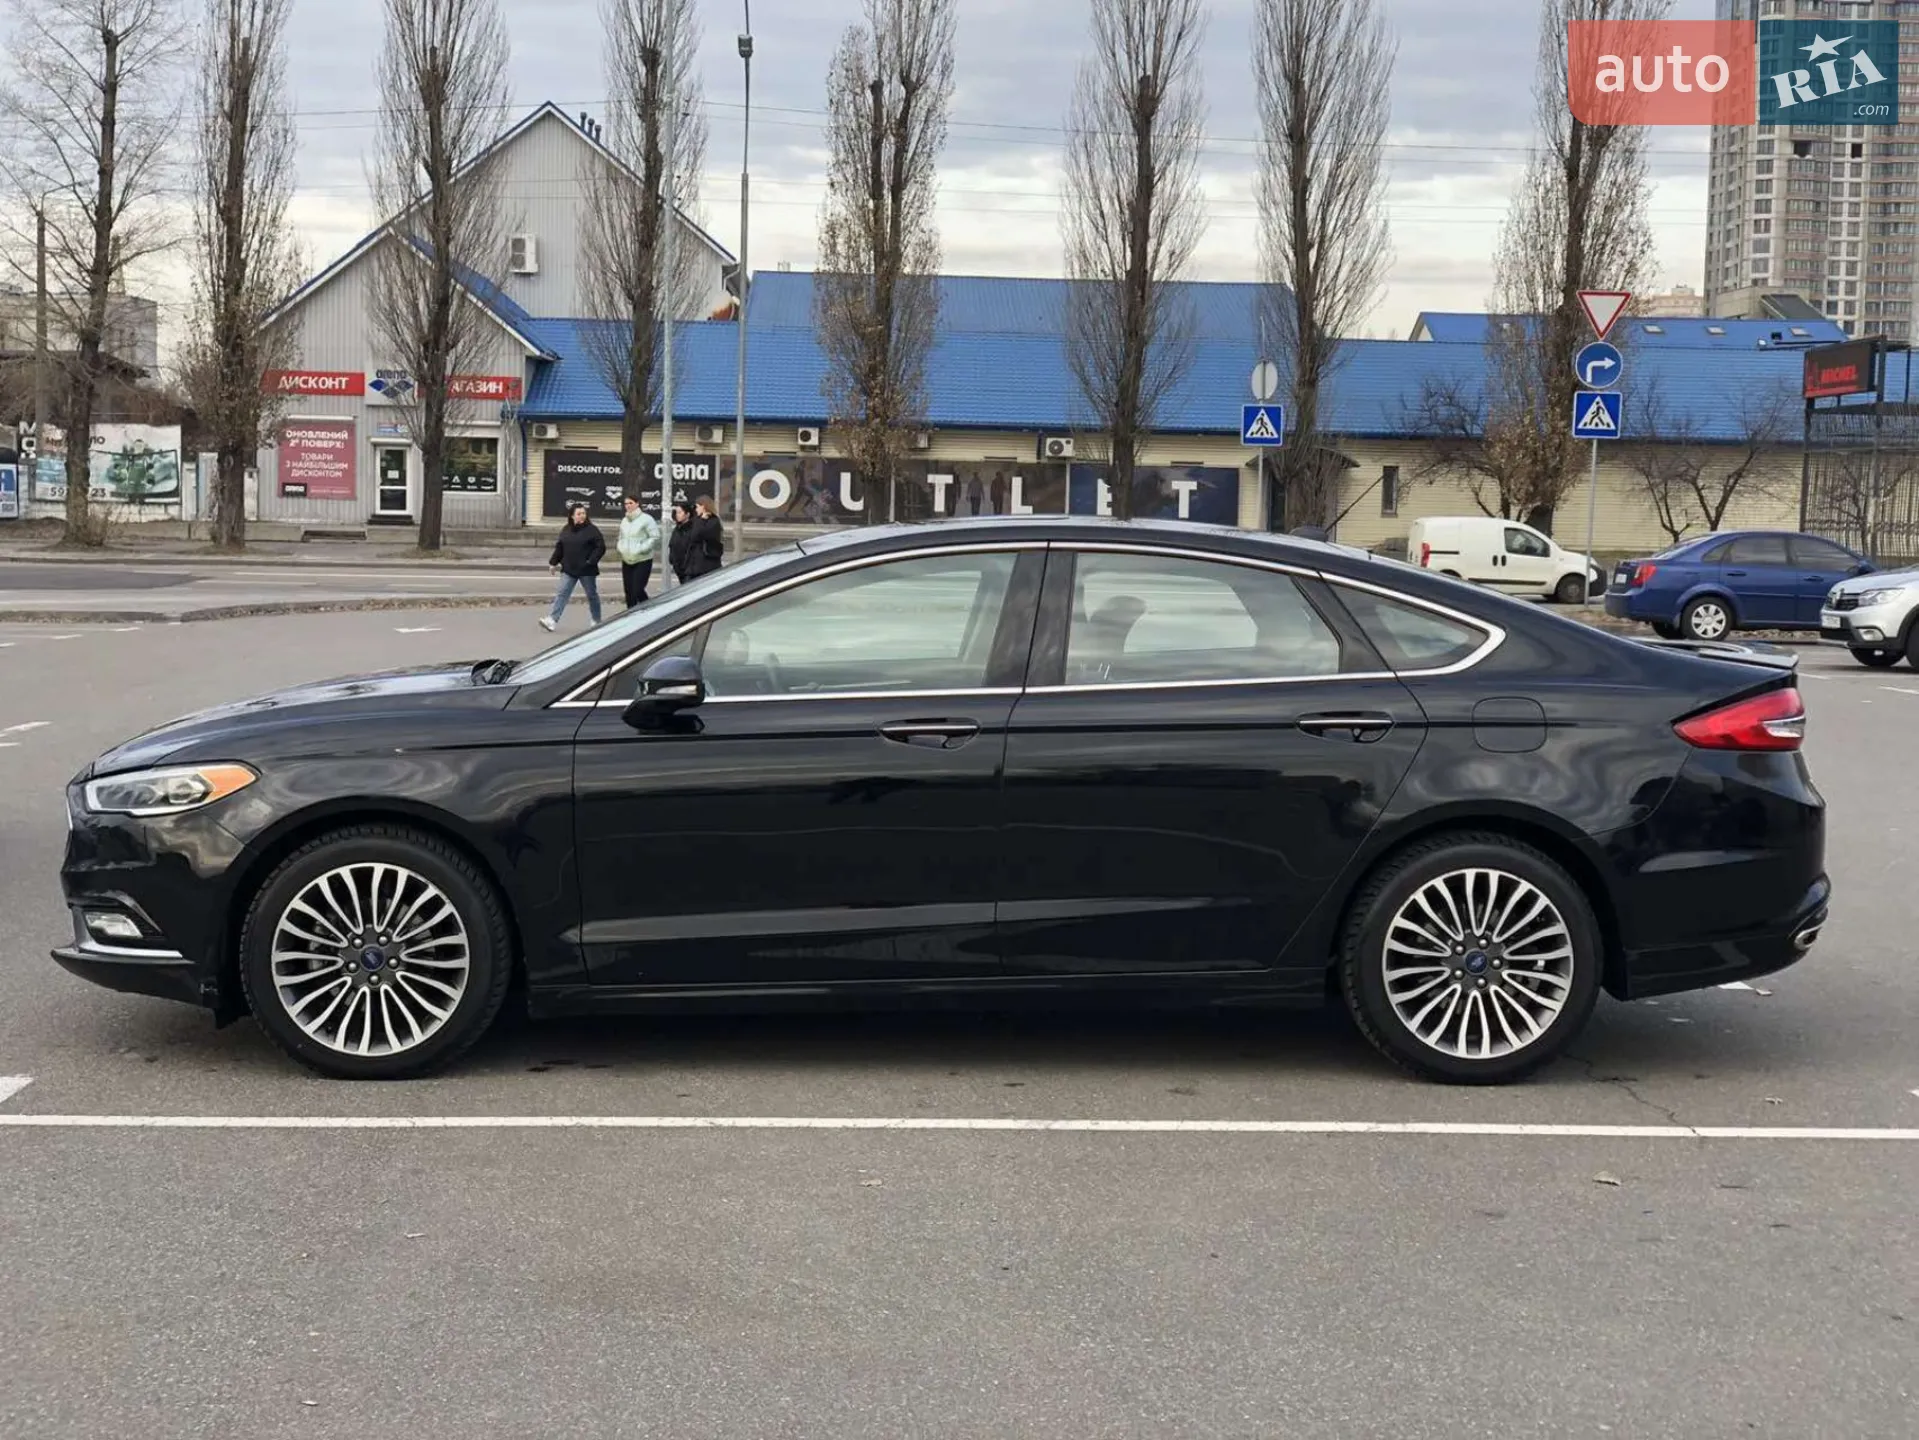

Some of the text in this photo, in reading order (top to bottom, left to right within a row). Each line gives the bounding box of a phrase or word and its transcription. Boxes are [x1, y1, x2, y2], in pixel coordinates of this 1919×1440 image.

[278, 375, 350, 390] ДИСКОНТ
[451, 380, 504, 395] АГАЗИН
[557, 464, 602, 474] DISCOUNT
[654, 462, 709, 481] aena
